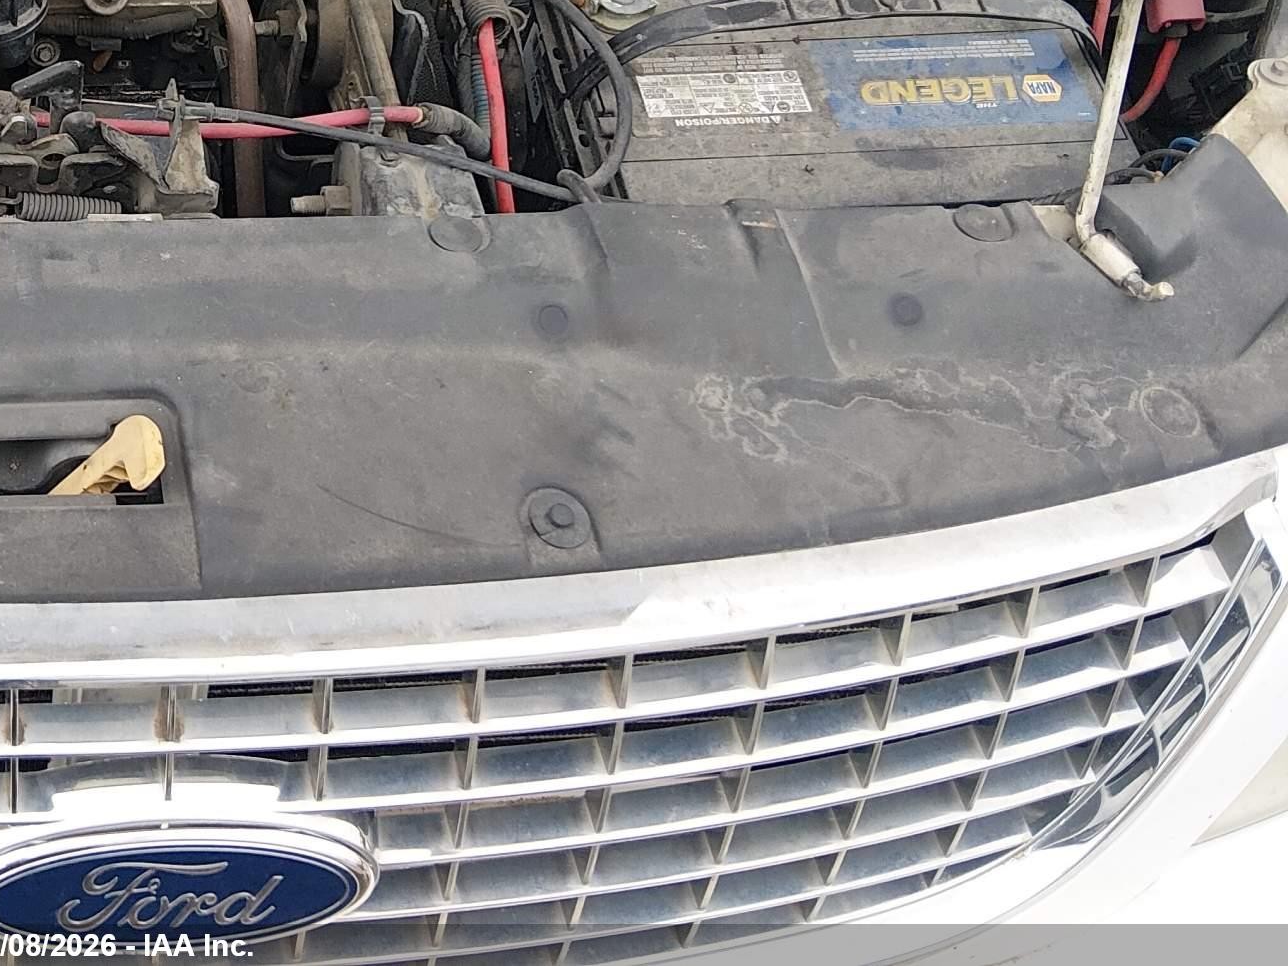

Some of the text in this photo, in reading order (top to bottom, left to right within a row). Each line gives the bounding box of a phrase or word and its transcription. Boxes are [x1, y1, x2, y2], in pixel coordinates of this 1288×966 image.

[860, 75, 1018, 106] LEGEND
[1027, 81, 1056, 95] NAPA
[56, 860, 284, 931] Ford
